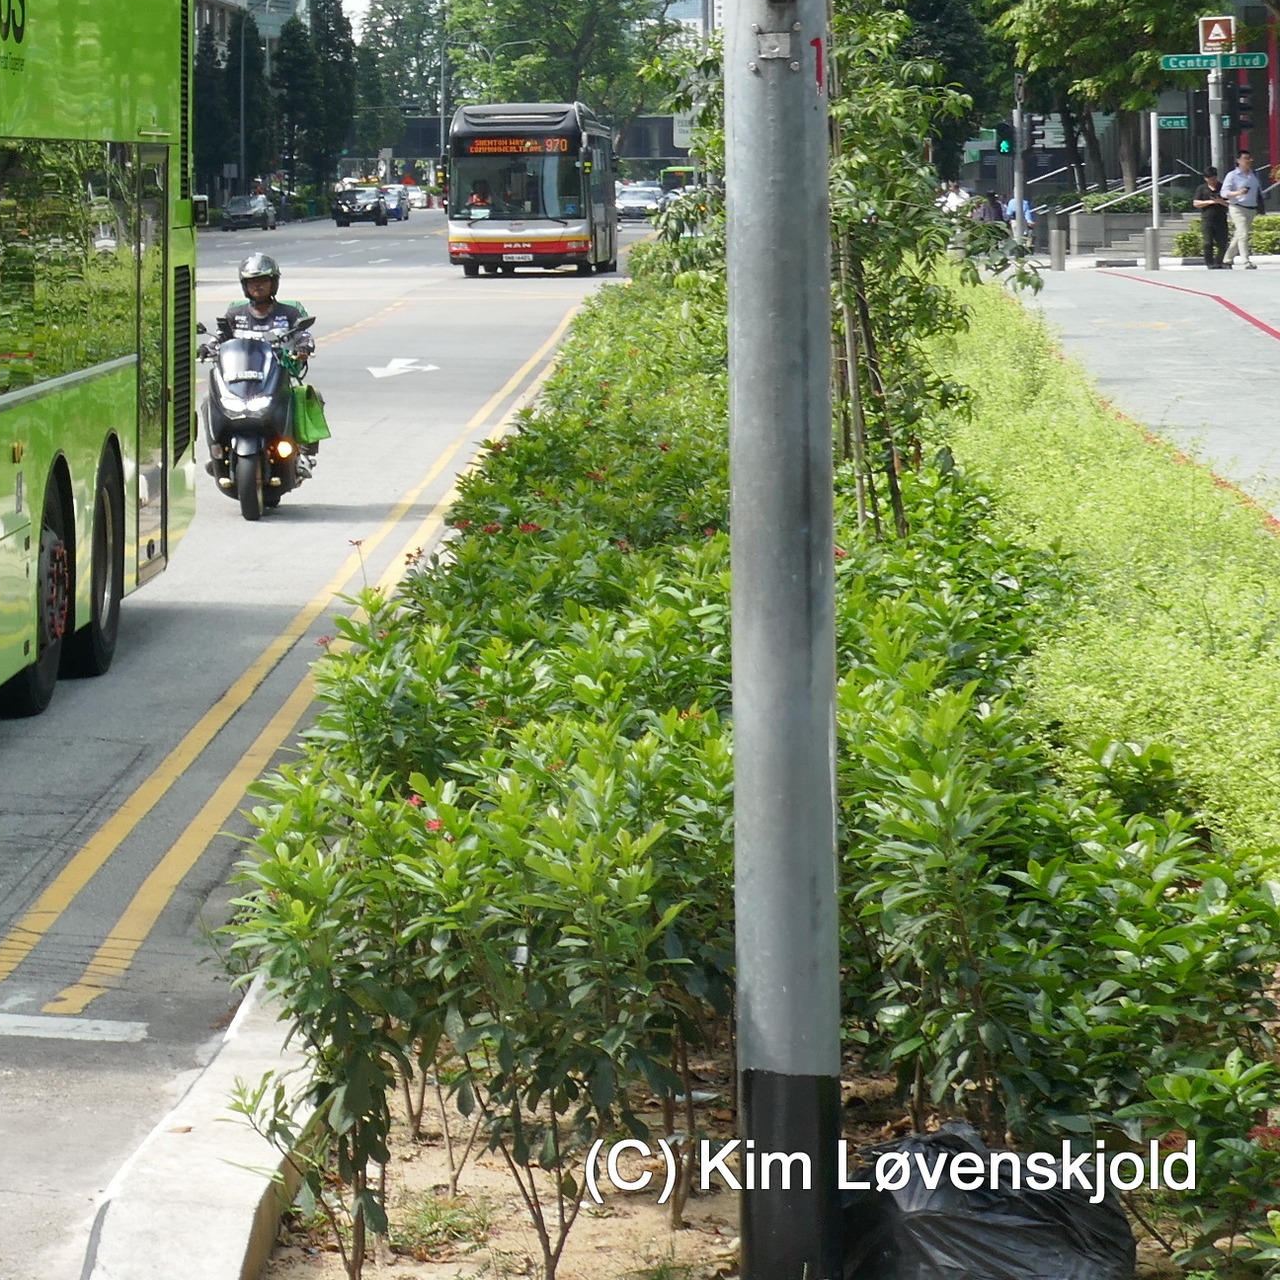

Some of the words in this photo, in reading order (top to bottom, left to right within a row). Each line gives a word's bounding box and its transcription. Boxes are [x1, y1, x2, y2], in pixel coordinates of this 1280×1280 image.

[1168, 56, 1218, 68] Centra
[1229, 55, 1261, 66] Blvd
[545, 138, 568, 152] 970
